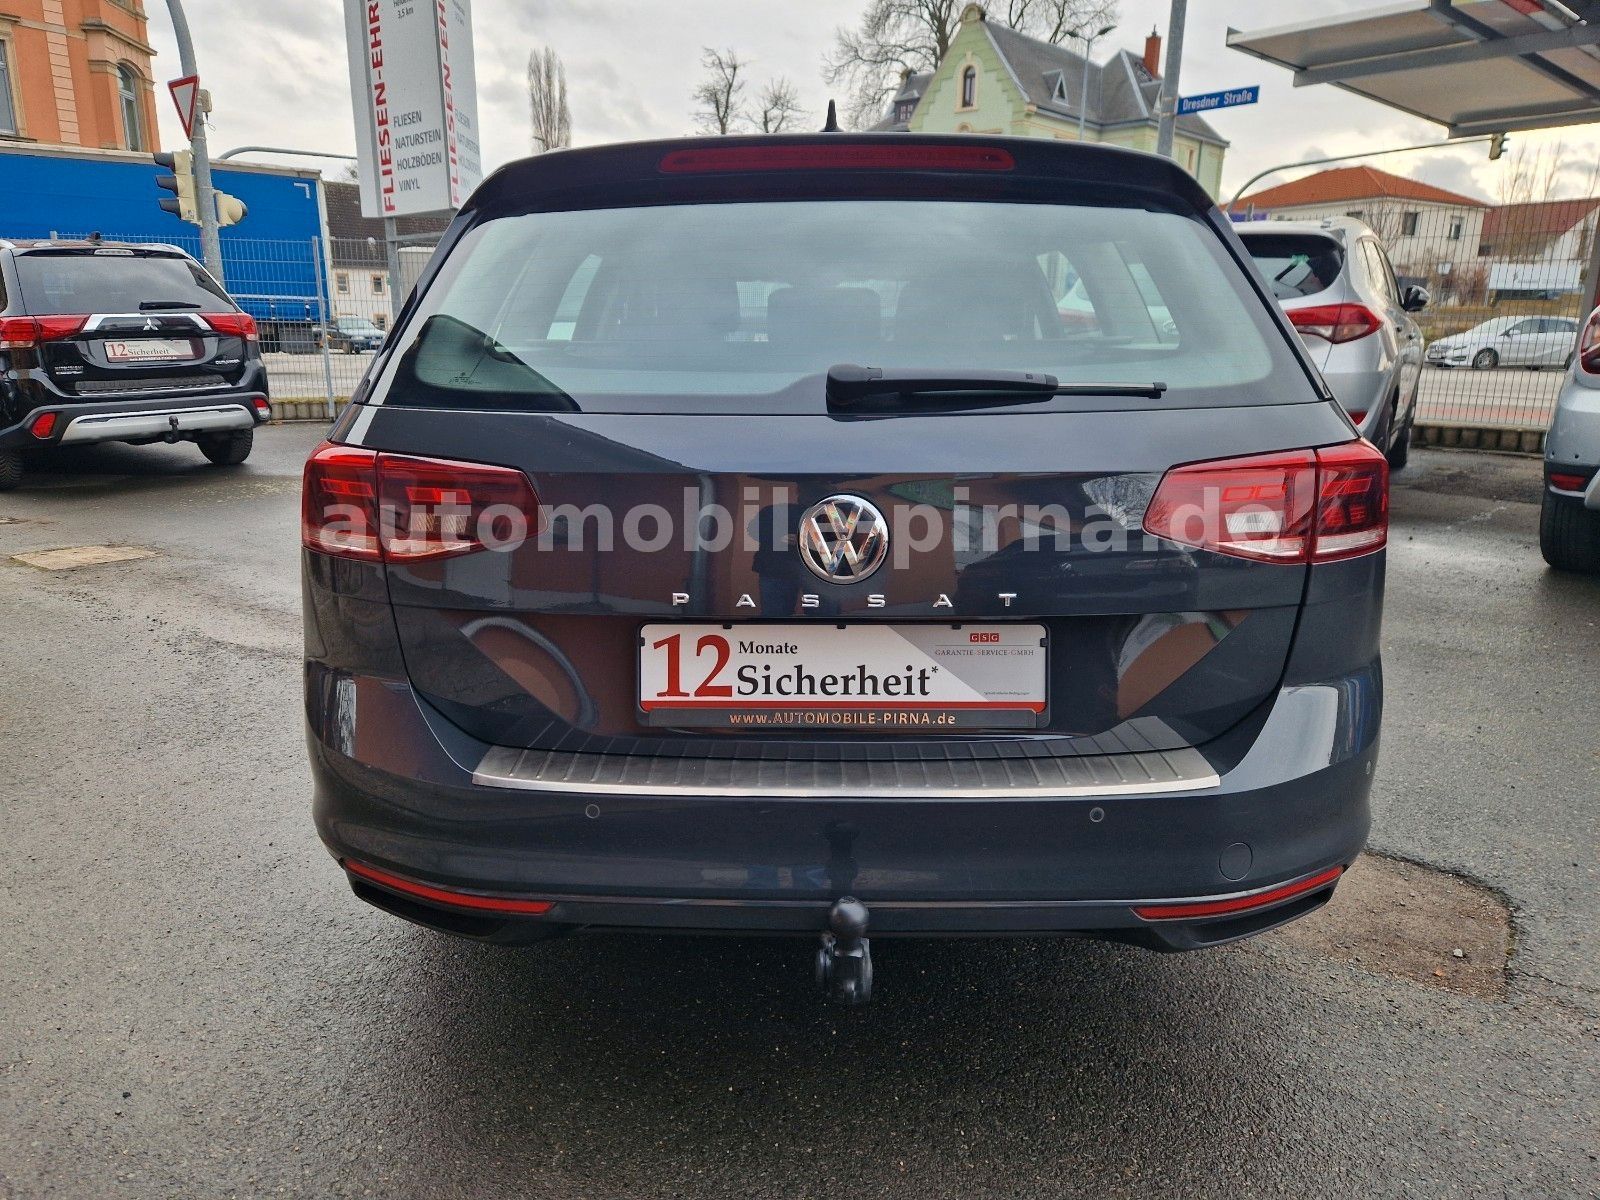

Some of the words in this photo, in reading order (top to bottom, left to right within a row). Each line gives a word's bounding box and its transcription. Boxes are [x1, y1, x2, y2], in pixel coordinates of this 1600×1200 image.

[368, 0, 396, 212] FLIESEN-EHR
[437, 0, 460, 204] FLIESEN-EH
[1182, 96, 1220, 111] Dresdner
[1223, 90, 1253, 105] Straße
[393, 110, 422, 128] FLIESEN
[395, 129, 442, 149] NATURSTEIN
[396, 152, 443, 171] HOLZBÖDEN
[398, 180, 420, 192] VINYL
[108, 343, 128, 356] 12
[672, 592, 1018, 608] PASSAT
[971, 633, 999, 642] GSG
[738, 640, 798, 655] Monate
[652, 633, 733, 697] 12
[729, 712, 956, 726] www.AUTOMOBILE-PIRNA.de
